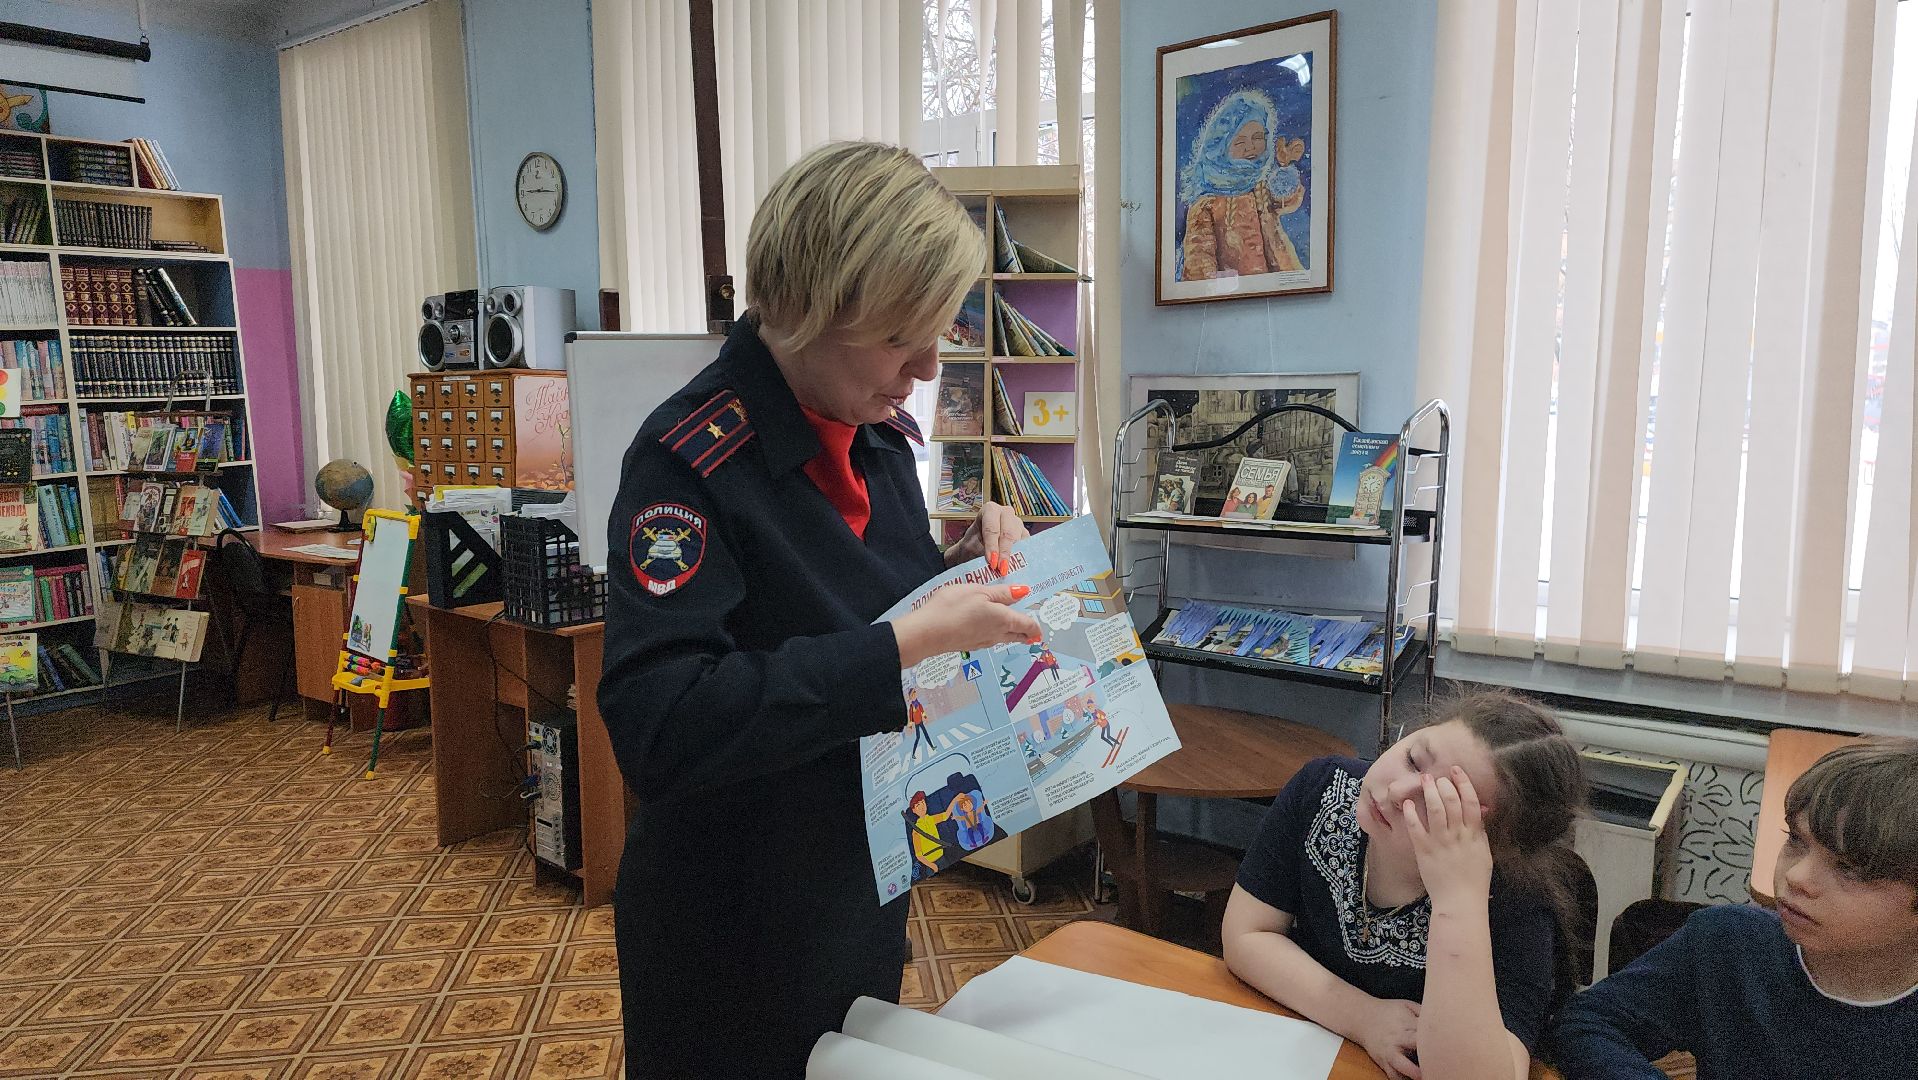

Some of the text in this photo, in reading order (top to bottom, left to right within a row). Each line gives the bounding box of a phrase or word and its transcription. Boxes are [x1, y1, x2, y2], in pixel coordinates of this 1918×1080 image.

[1032, 398, 1070, 427] 3+
[1240, 465, 1281, 481] СЕМЬЯ
[635, 506, 702, 528] ПОЛИЦИЯ
[965, 551, 1029, 585] ВНИМИЕ!
[648, 579, 676, 595] МВД
